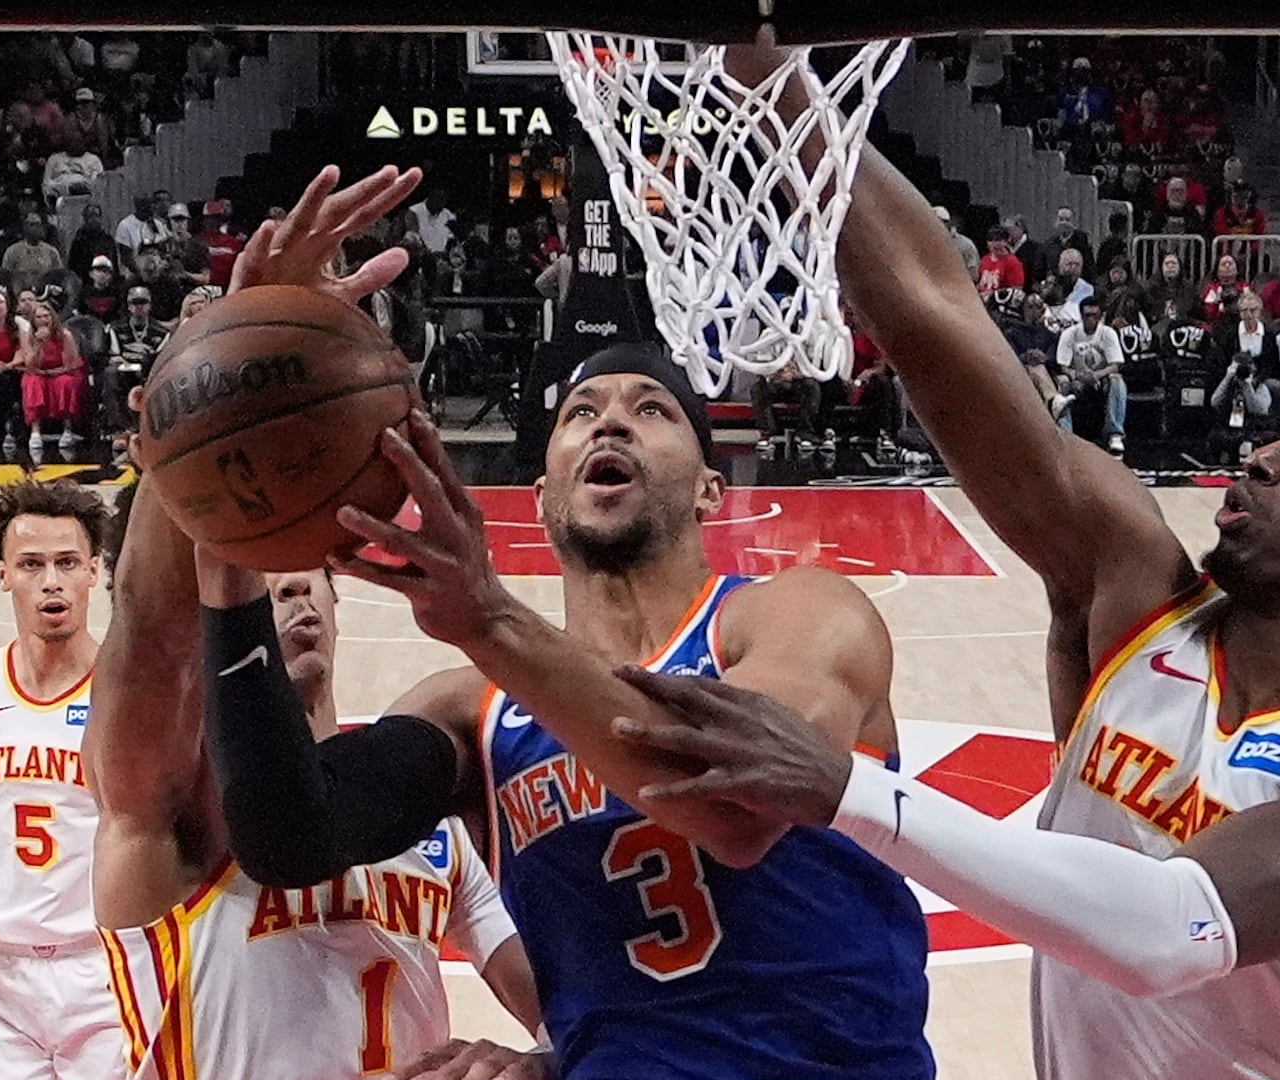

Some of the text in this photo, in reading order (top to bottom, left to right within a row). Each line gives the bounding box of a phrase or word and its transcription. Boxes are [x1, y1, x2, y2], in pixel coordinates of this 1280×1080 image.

[413, 107, 552, 136] DELTA
[584, 200, 611, 223] GET
[584, 224, 611, 247] THE
[590, 248, 617, 277] App
[575, 319, 618, 336] Google
[495, 752, 608, 856] NEW
[14, 803, 58, 875] 5
[247, 866, 451, 947] ATLANT
[600, 818, 722, 982] 3
[358, 957, 400, 1078] 1
